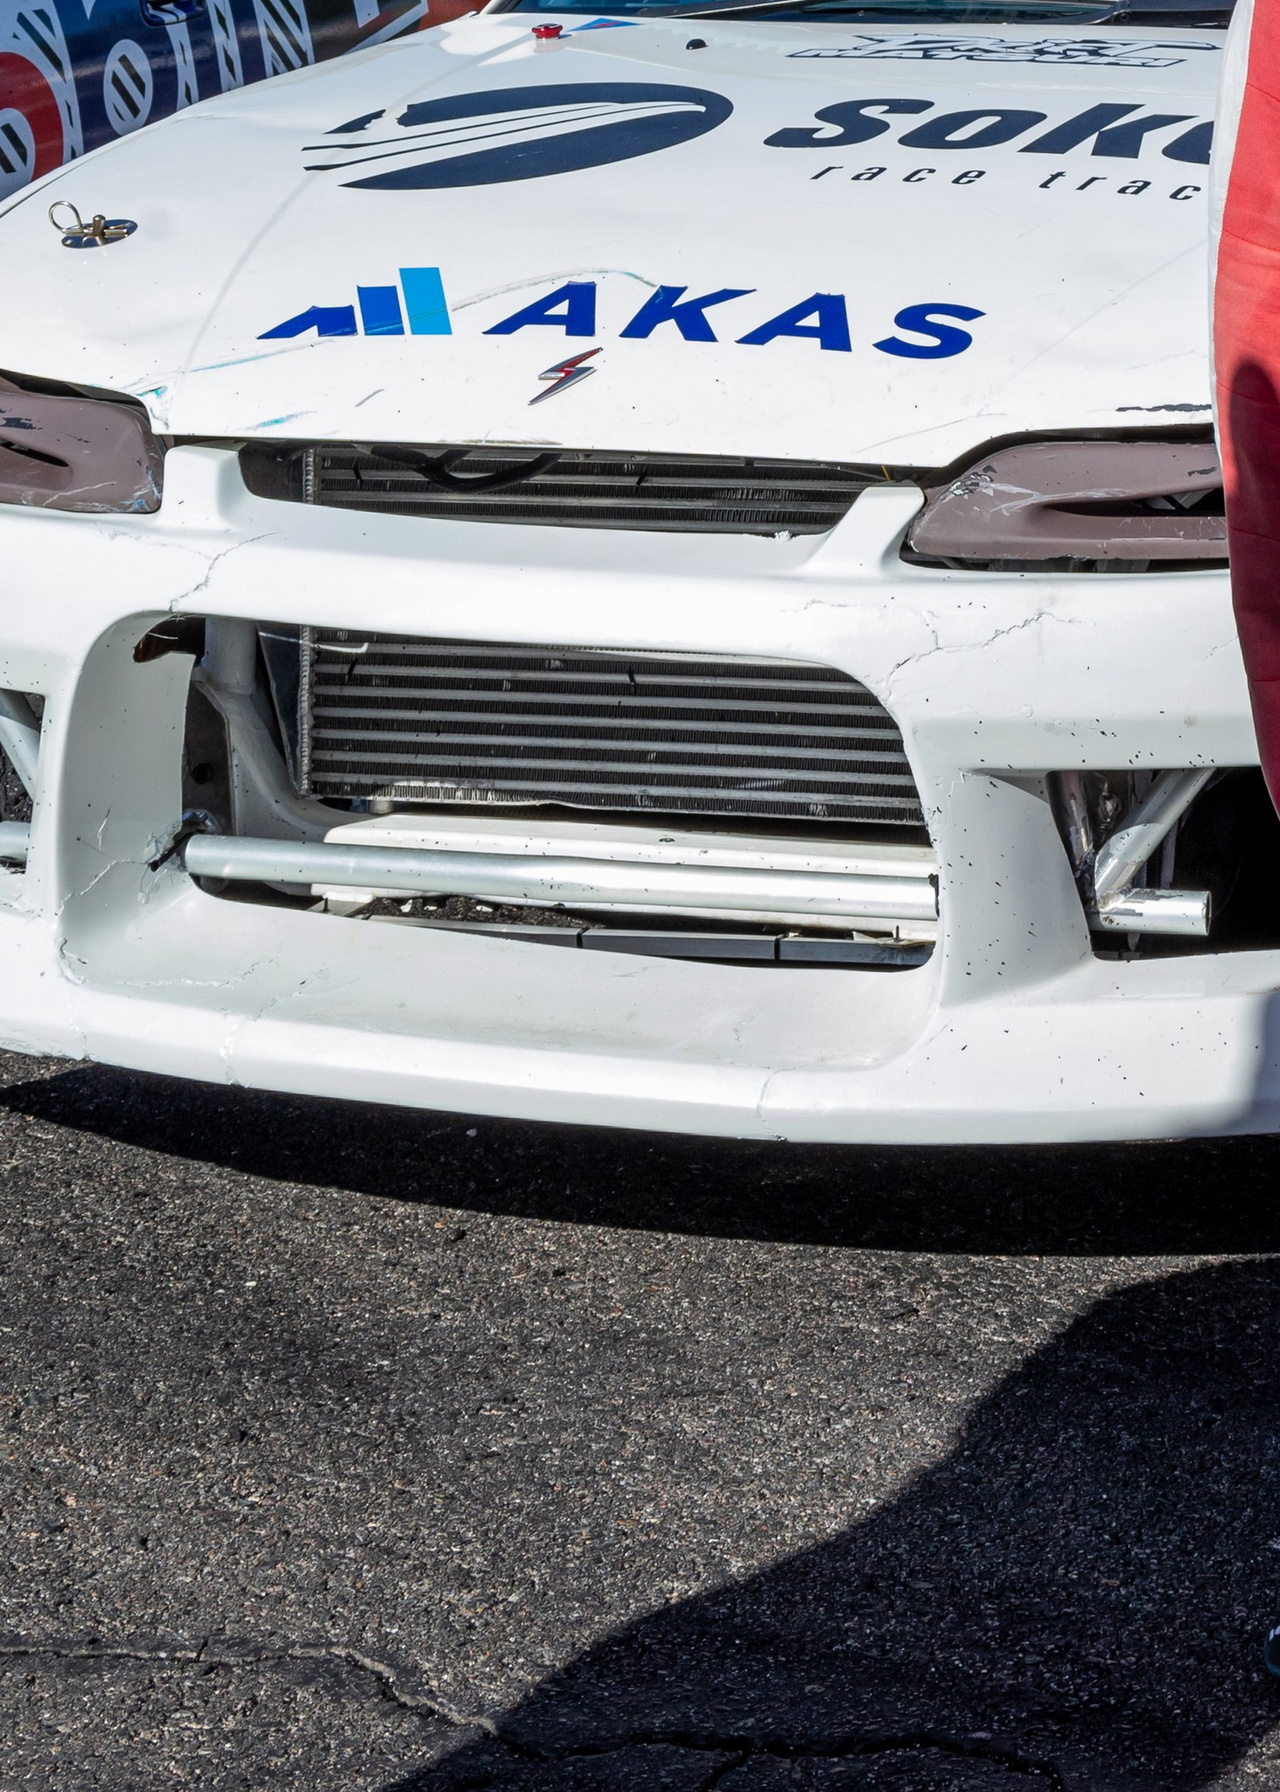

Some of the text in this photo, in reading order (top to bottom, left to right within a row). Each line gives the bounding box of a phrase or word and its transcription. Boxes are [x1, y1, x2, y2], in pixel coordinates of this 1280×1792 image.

[763, 97, 1214, 166] Sok
[809, 162, 1202, 201] race trac
[483, 281, 987, 359] AKAS
